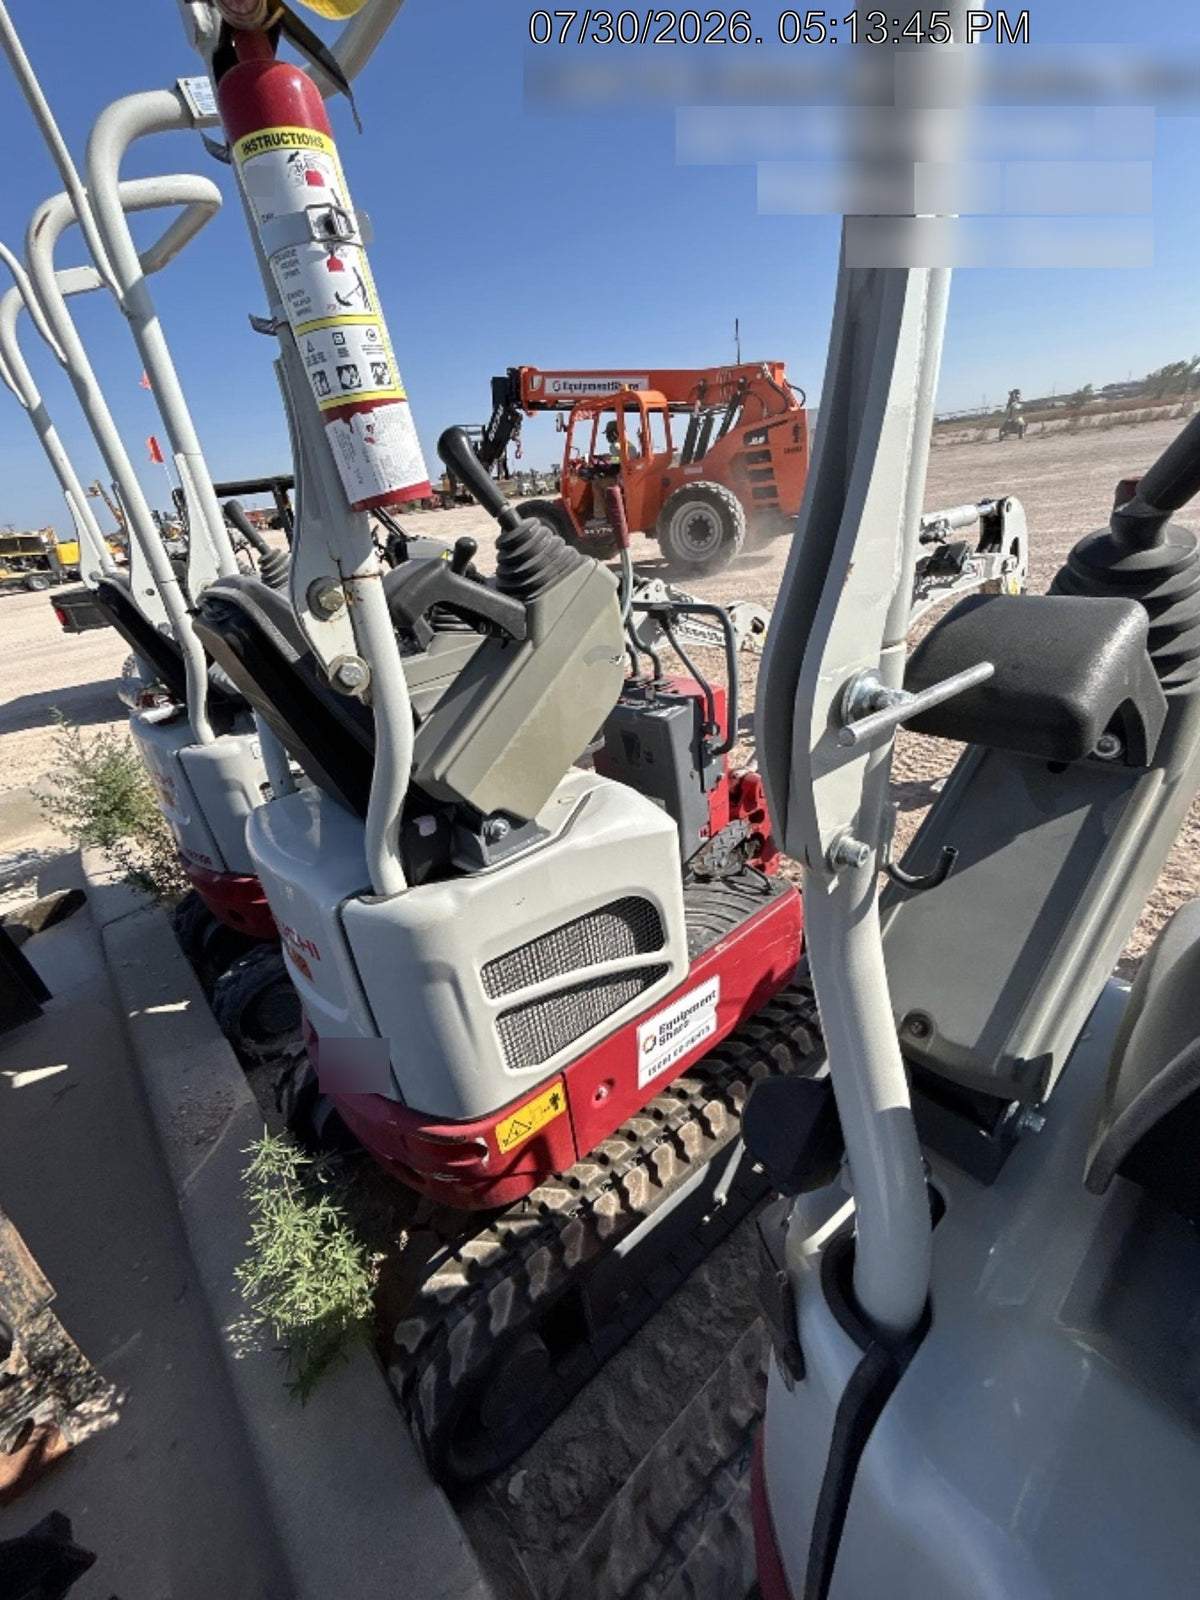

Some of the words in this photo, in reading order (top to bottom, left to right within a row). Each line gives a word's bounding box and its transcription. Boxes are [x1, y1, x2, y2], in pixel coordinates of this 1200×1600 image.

[241, 133, 325, 156] INSTRUCTIONS
[658, 989, 717, 1036] Equipment
[658, 1019, 691, 1047] Share
